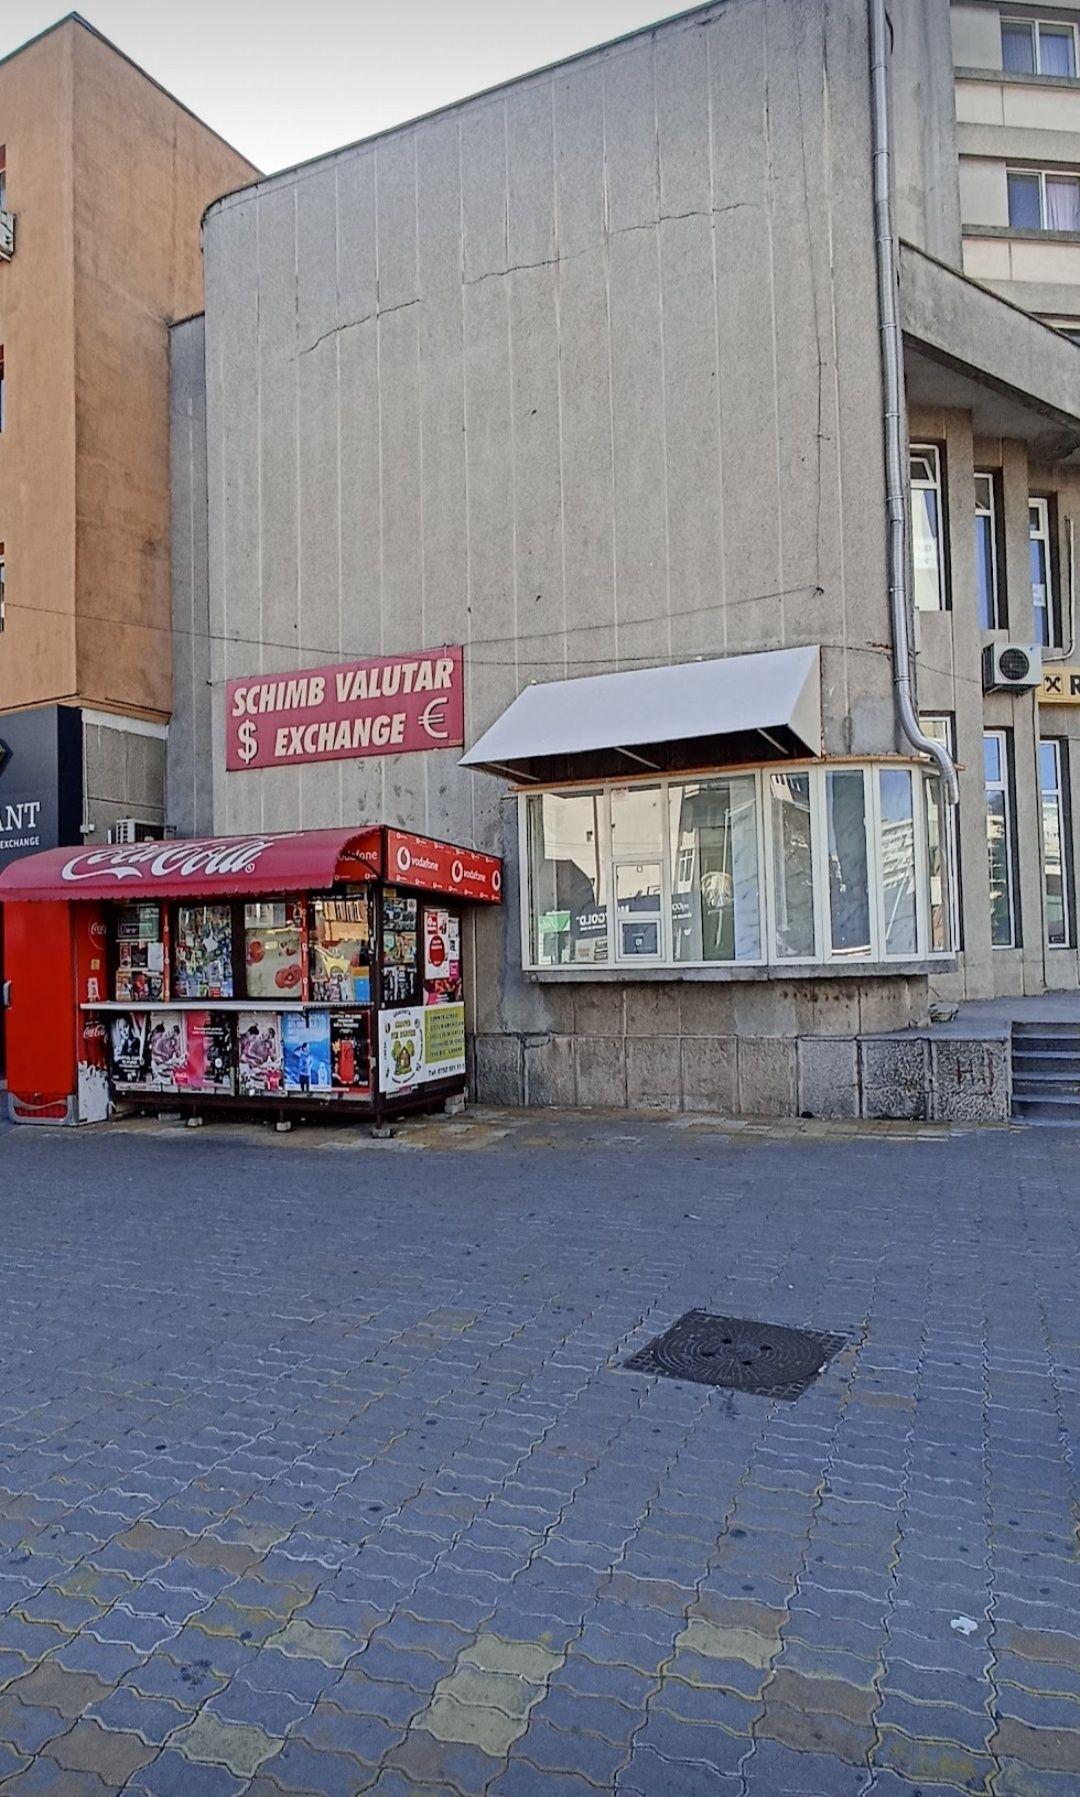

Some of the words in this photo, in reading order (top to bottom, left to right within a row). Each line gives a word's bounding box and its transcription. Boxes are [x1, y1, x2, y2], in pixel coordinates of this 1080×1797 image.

[232, 675, 326, 717] SCHIMB
[335, 657, 454, 703] VALUTAR
[237, 719, 258, 764] $
[273, 713, 406, 757] EXCHANGE
[418, 697, 448, 739] €
[0, 836, 40, 849] EXCHANGE
[411, 857, 439, 871] vodafone
[463, 869, 486, 883] vodafone
